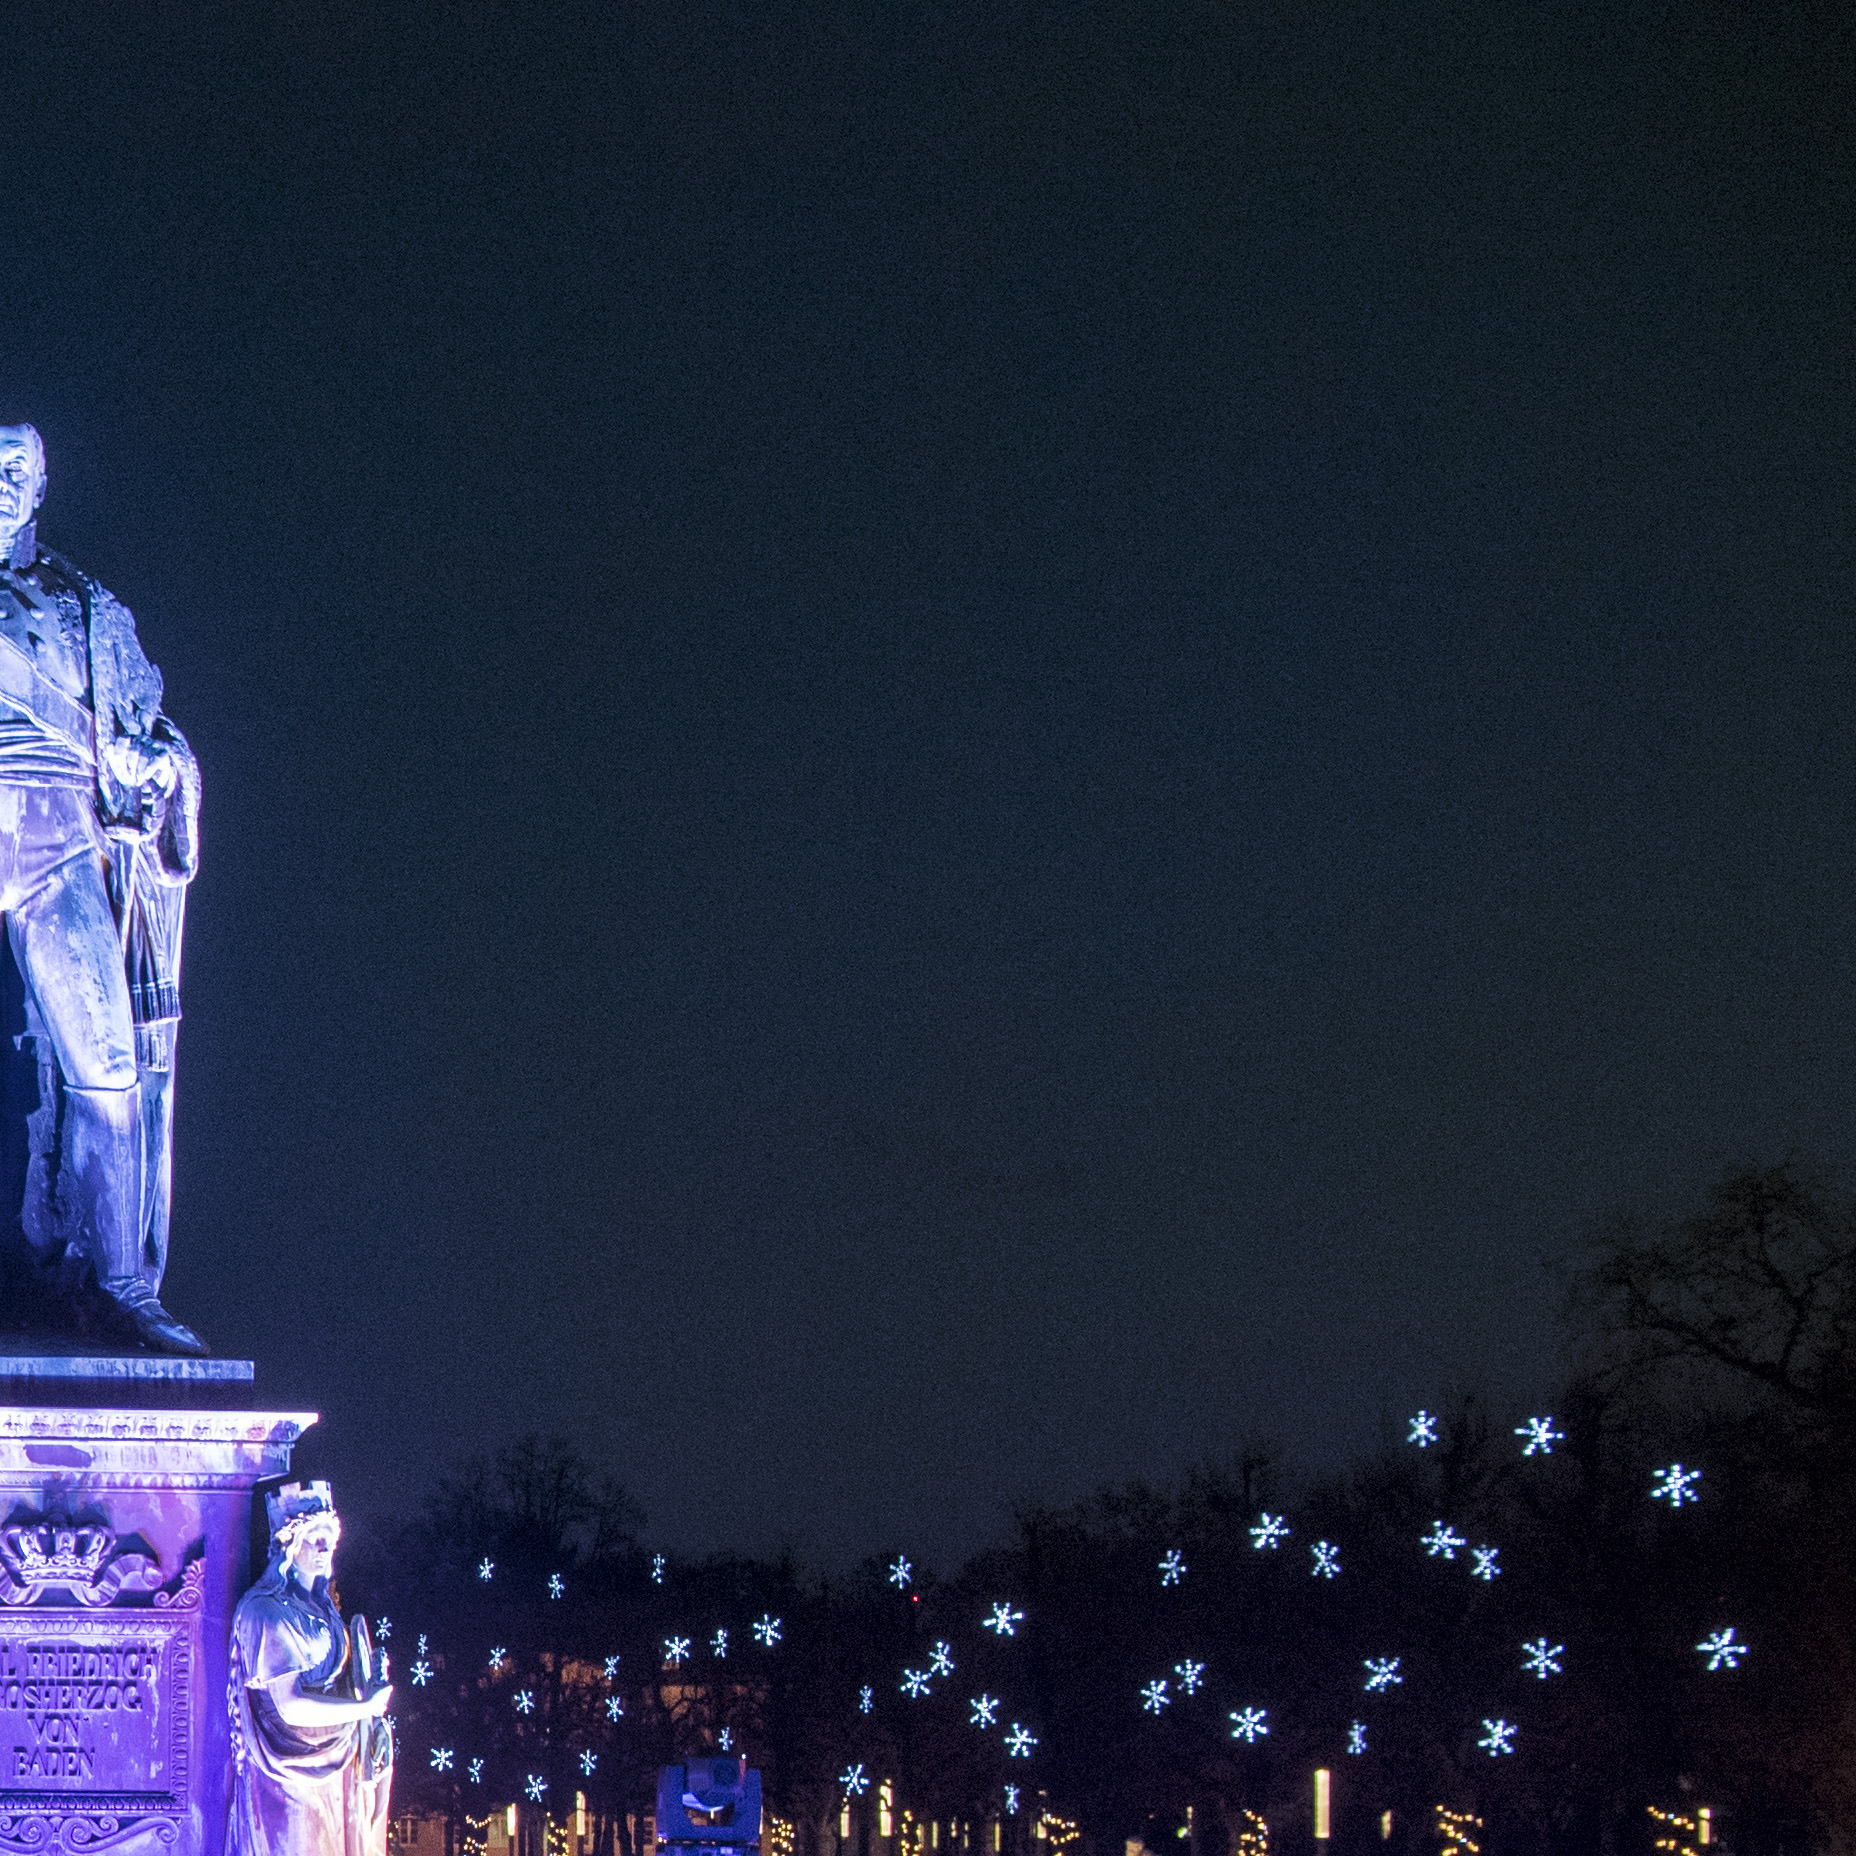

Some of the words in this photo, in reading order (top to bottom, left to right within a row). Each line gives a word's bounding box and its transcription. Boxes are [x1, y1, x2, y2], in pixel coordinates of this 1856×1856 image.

[26, 1645, 158, 1680] FRIEDRICH
[27, 1713, 81, 1746] VON
[12, 1747, 95, 1780] BADEN
